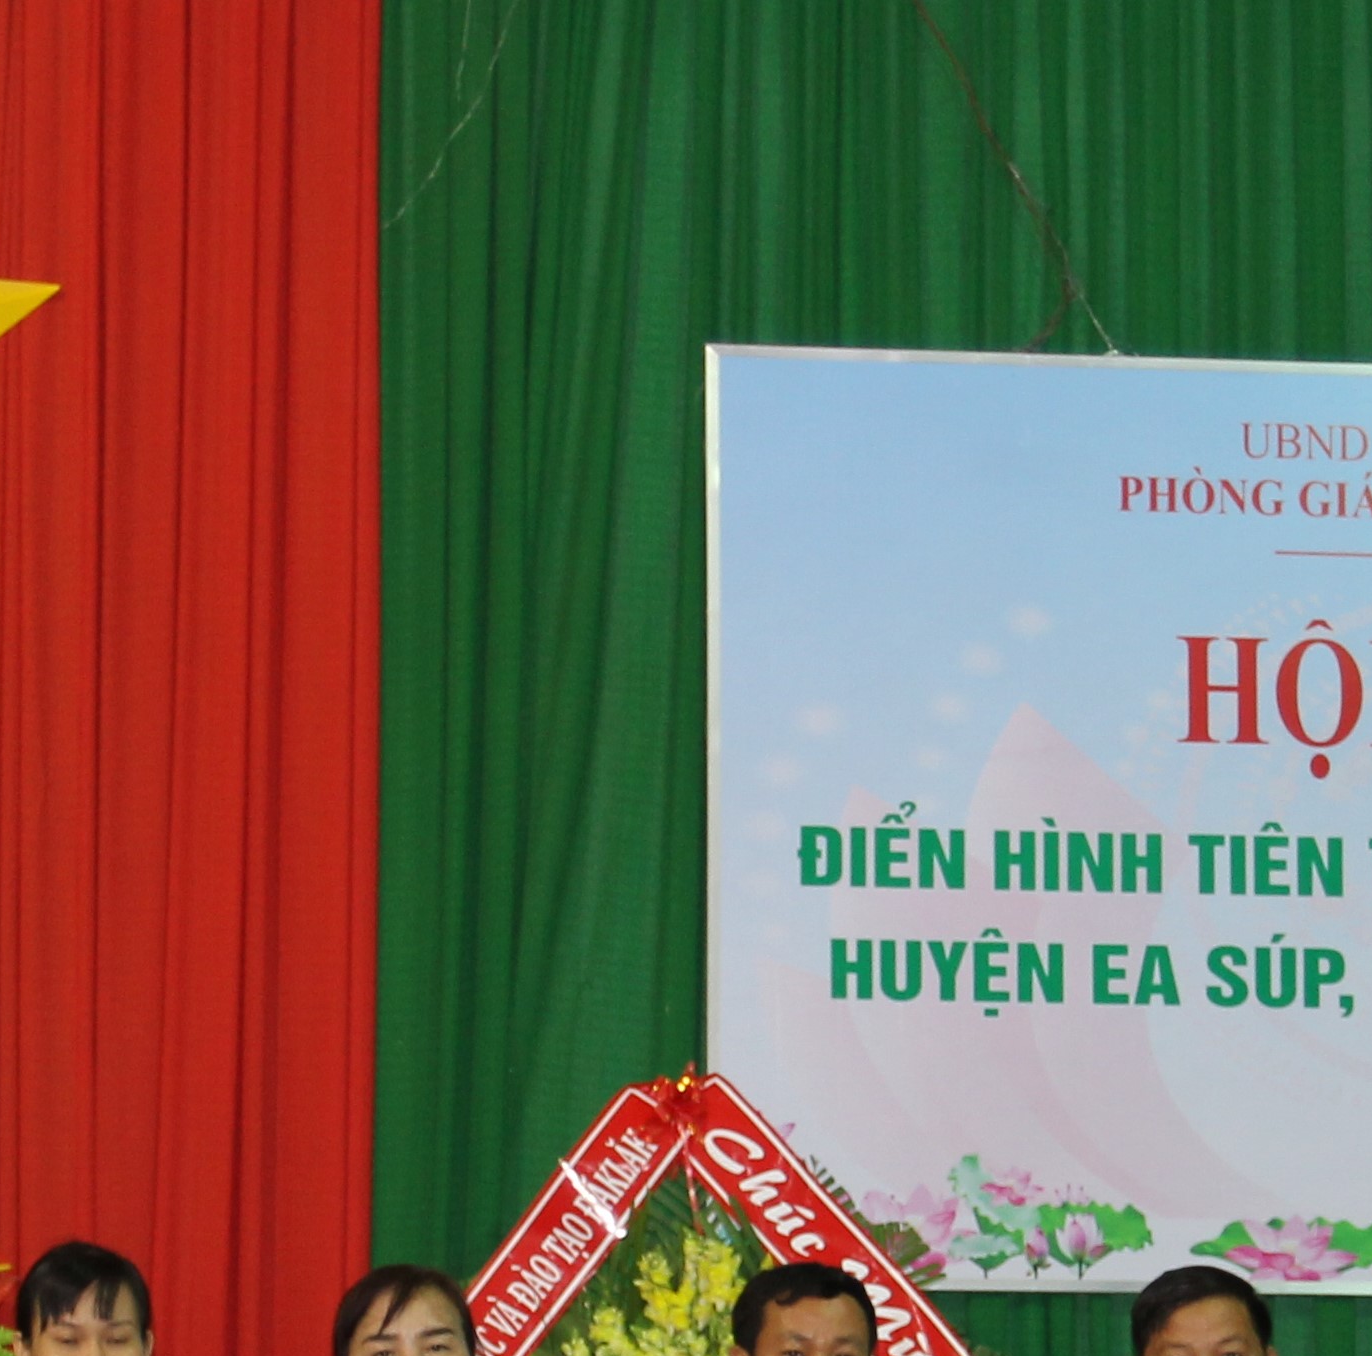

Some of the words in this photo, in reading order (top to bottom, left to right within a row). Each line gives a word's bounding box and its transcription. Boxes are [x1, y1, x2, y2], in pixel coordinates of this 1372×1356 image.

[1241, 422, 1369, 461] UBND
[1118, 466, 1284, 517] PHÒNG
[797, 801, 966, 890] ĐIỂN
[993, 817, 1163, 894] HÌNH
[1188, 821, 1345, 898] TIÊN
[830, 927, 1065, 1017] HUYỆN
[1092, 943, 1181, 1006] EA
[1206, 933, 1355, 1017] SÚP,
[703, 1127, 826, 1258] Chúc
[540, 1211, 594, 1265] TẠO
[506, 1254, 563, 1314] ĐÀO
[483, 1295, 530, 1339] VÀ
